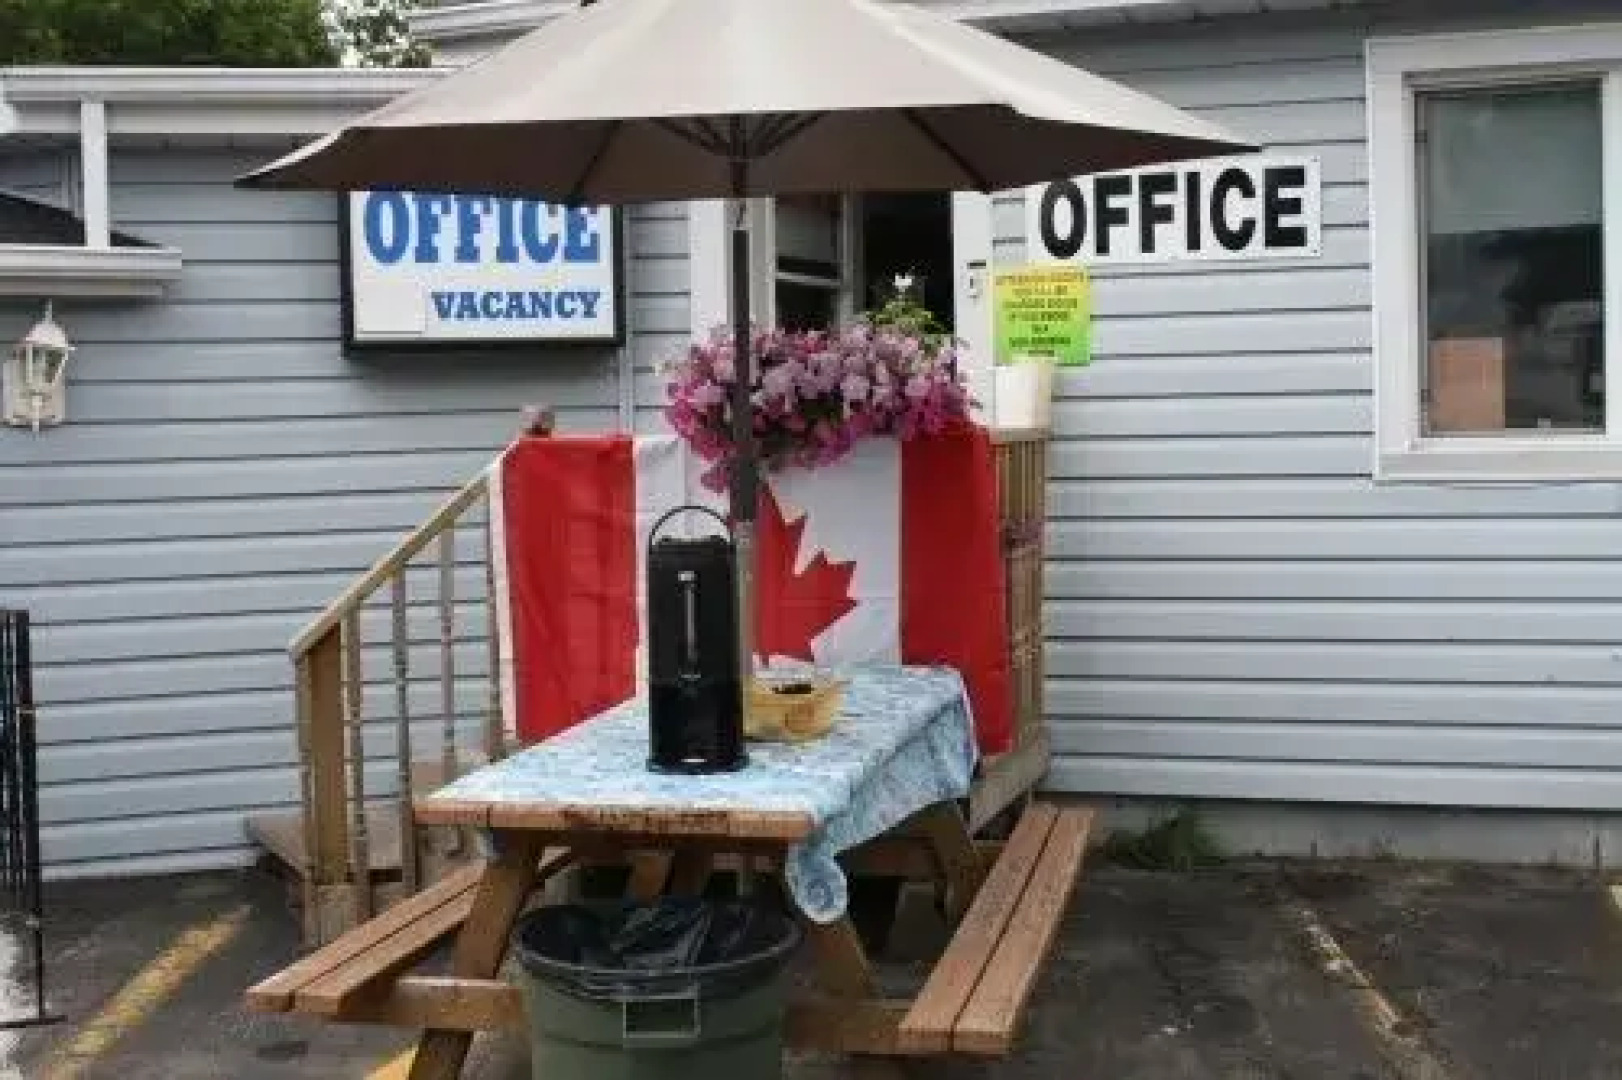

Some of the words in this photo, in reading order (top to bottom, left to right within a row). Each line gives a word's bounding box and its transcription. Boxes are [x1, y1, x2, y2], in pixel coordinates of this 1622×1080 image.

[364, 189, 600, 263] OFFICE
[1040, 166, 1306, 258] OFFICE
[431, 291, 600, 318] VACANCY
